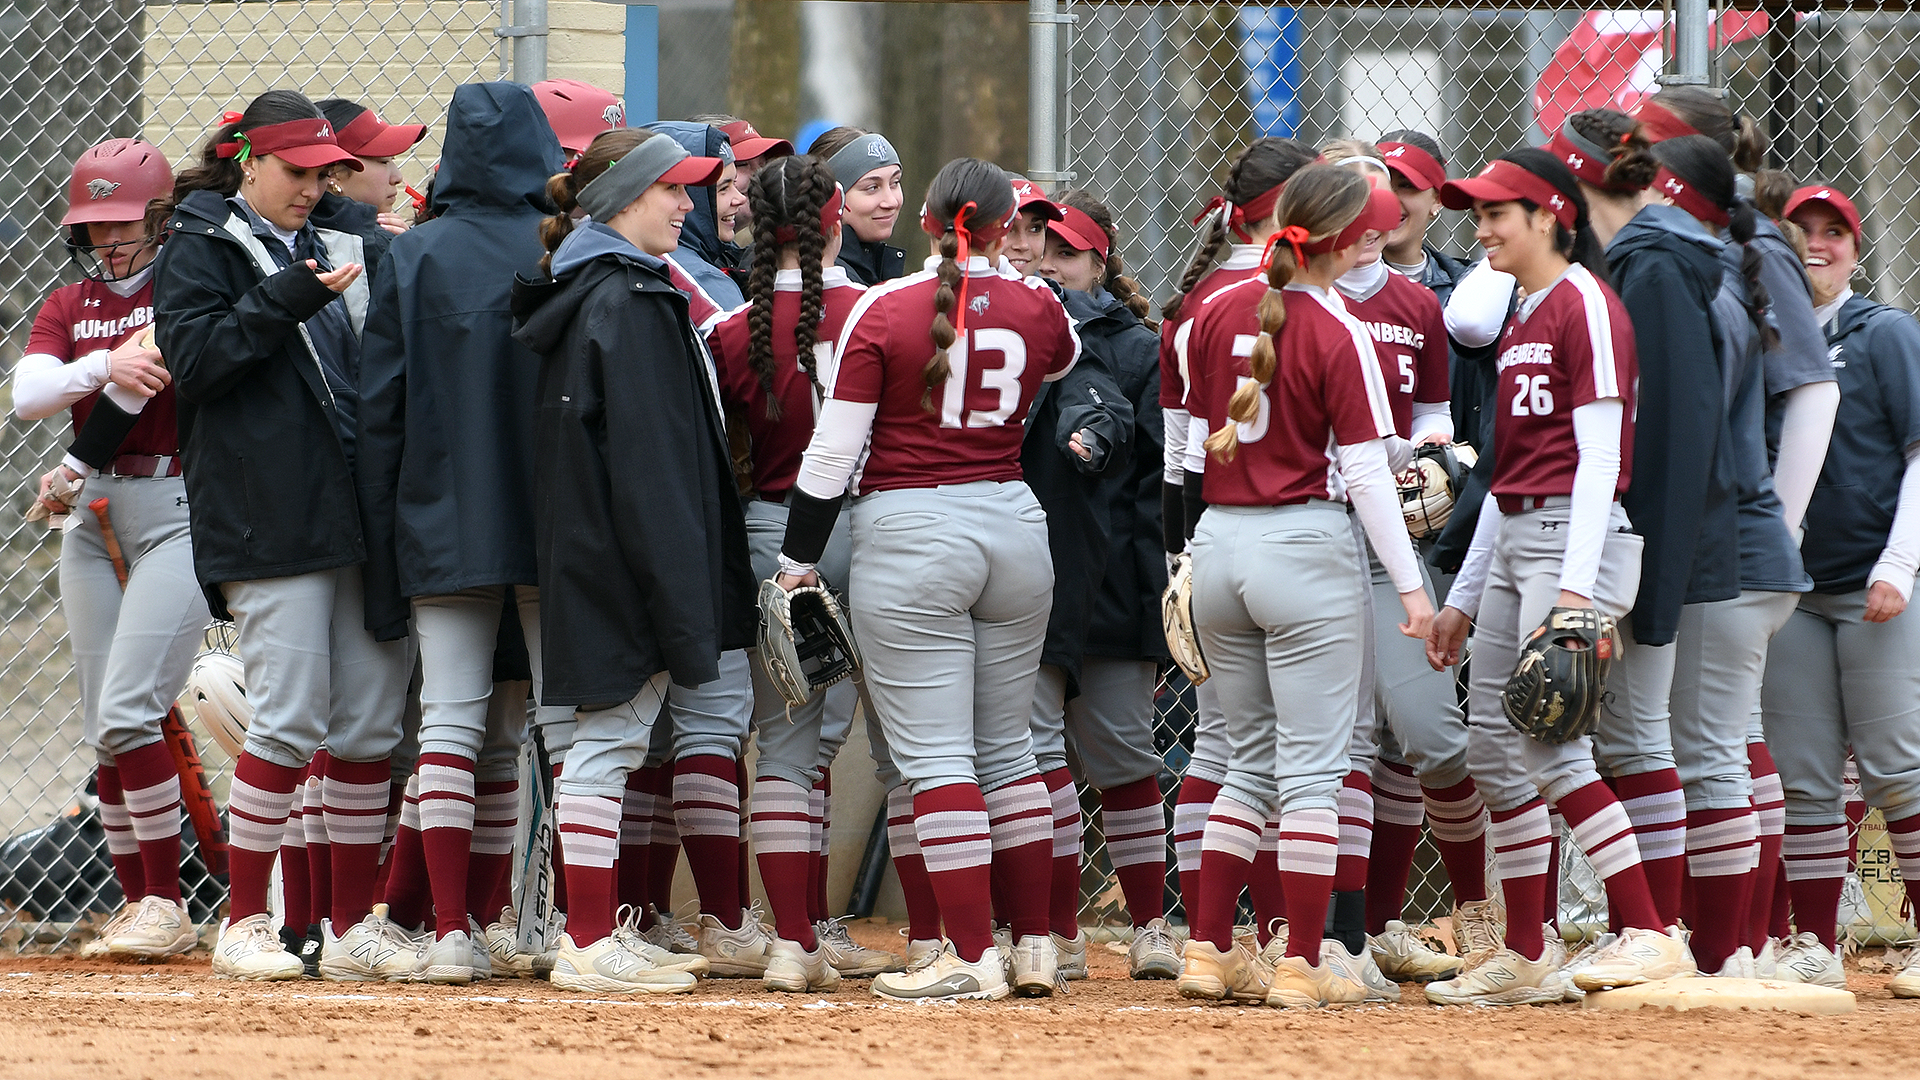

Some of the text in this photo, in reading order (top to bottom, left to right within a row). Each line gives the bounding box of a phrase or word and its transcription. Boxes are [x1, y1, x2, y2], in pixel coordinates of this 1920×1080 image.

[1361, 321, 1425, 350] NBERG
[939, 328, 1027, 429] 13
[1397, 354, 1415, 394] 5
[1511, 374, 1554, 416] 26
[534, 822, 551, 947] GHOST
